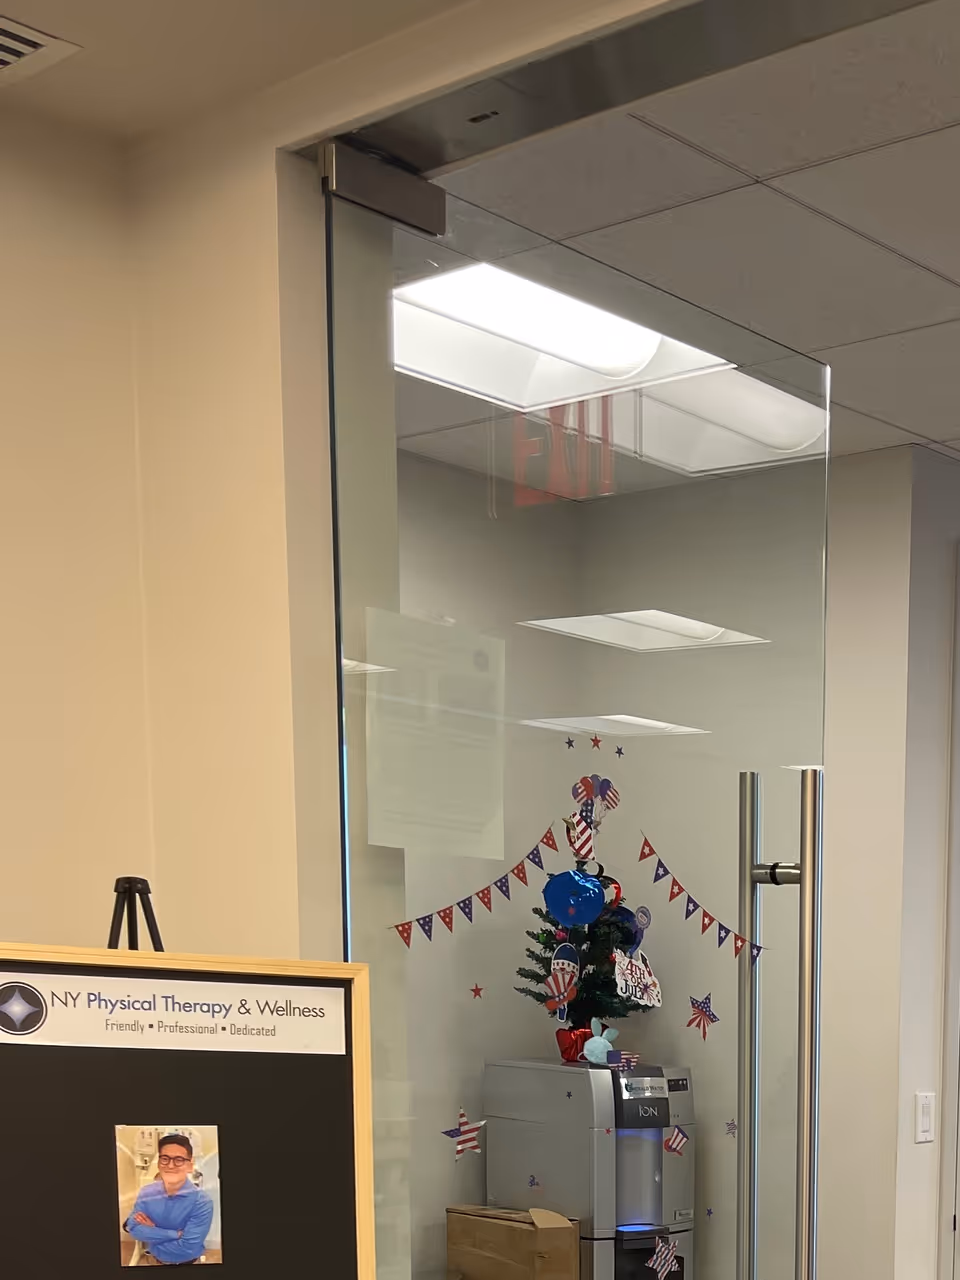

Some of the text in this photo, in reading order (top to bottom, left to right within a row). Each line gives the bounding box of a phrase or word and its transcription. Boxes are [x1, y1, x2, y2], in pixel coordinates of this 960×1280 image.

[626, 959, 646, 980] 4TH
[50, 991, 326, 1019] NY Physical Therapy & Wellness
[105, 1018, 277, 1038] Friendly Professional Dedicated
[638, 1104, 659, 1117] ION
